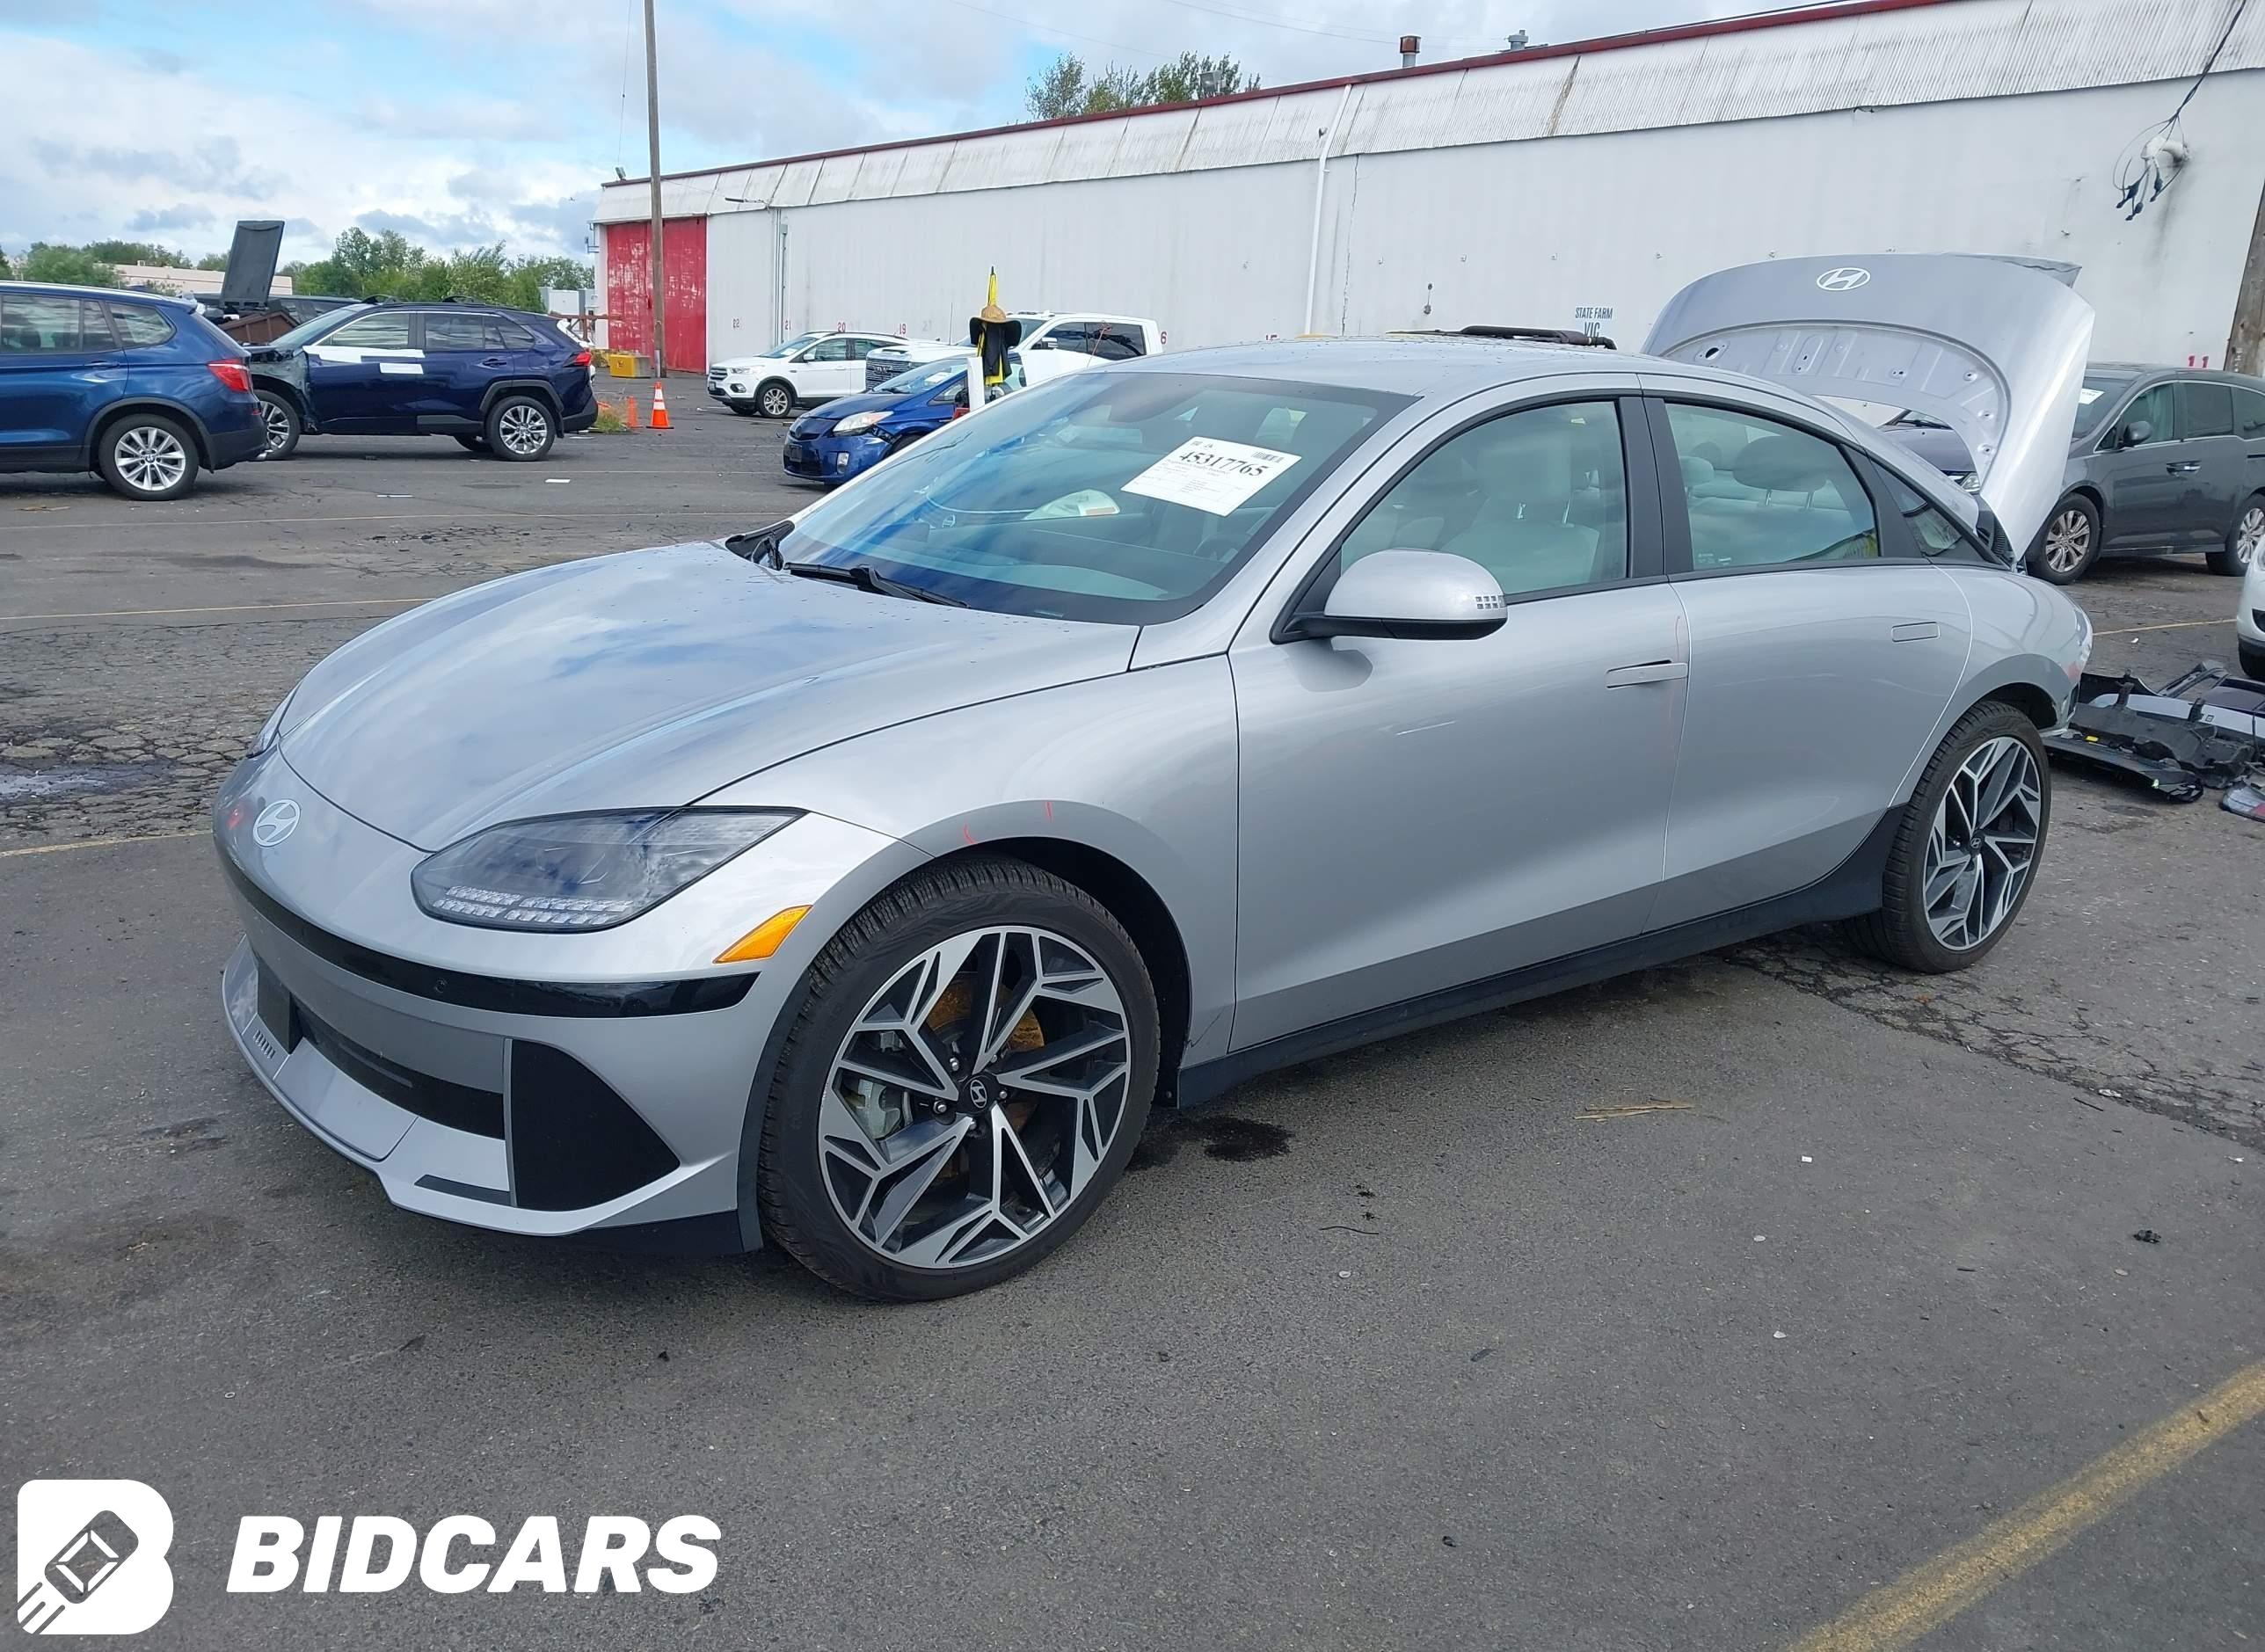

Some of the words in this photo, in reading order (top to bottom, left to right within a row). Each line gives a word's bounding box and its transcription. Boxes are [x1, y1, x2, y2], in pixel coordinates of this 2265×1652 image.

[1575, 307, 1593, 318] STATE
[1594, 308, 1613, 319] FARM
[837, 322, 846, 333] 20
[899, 324, 907, 335] 19
[1584, 322, 1600, 337] VIC
[2188, 355, 2210, 368] 11
[1179, 450, 1271, 477] 45317765
